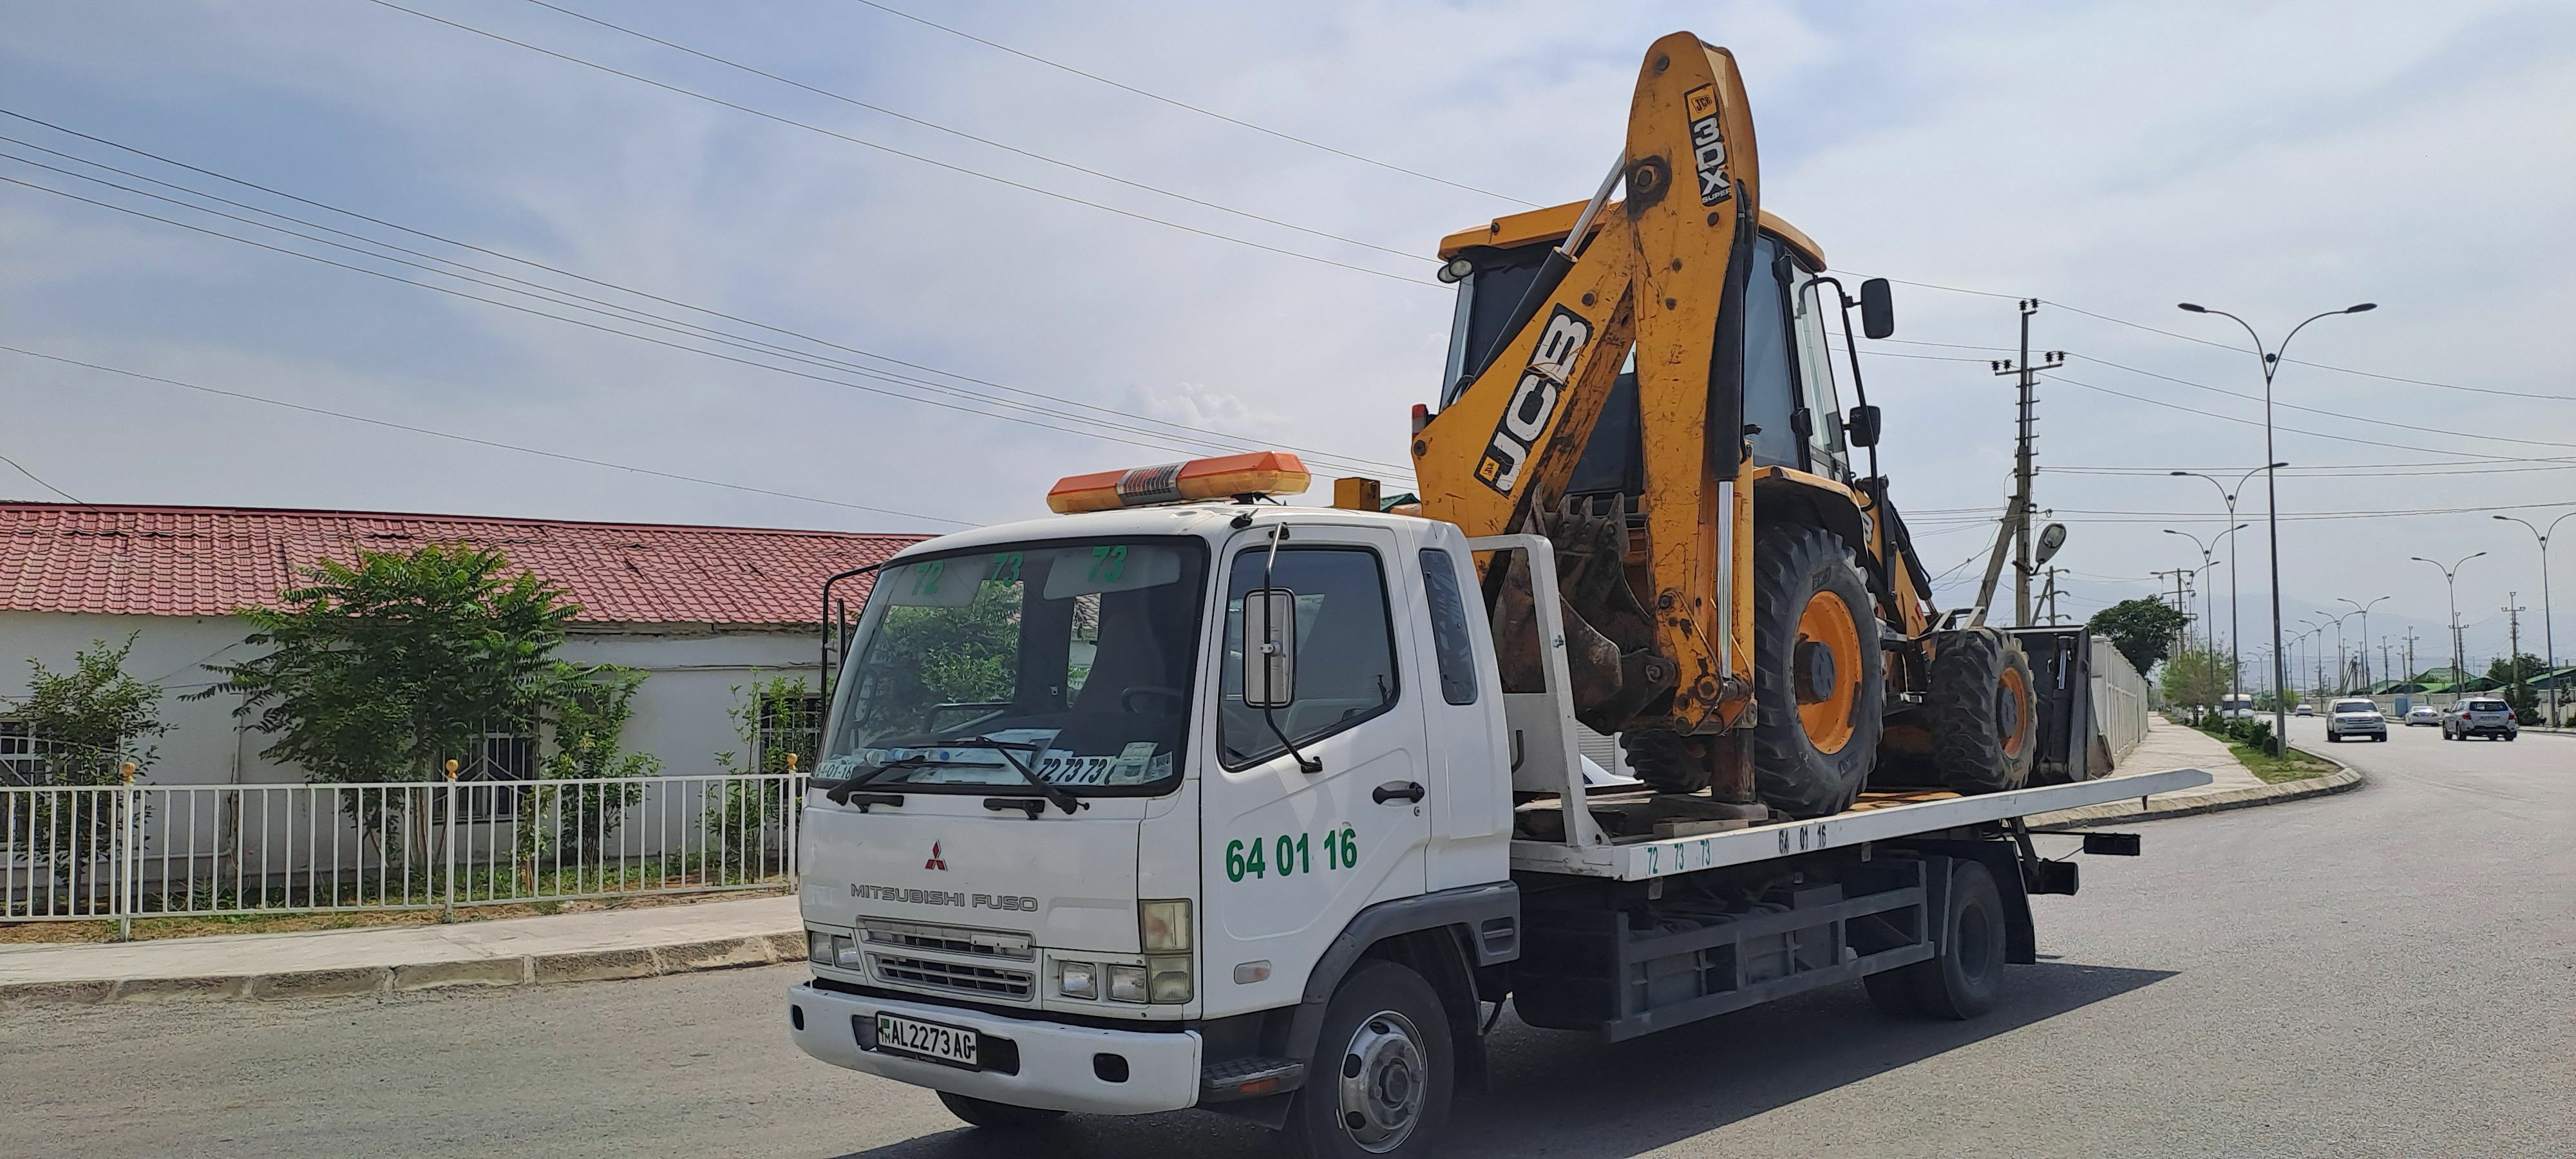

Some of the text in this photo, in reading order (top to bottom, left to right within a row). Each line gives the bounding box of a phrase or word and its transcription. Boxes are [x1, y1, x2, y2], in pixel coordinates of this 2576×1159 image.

[1695, 96, 1712, 111] JCB
[1694, 117, 1730, 196] 3DX
[1702, 190, 1732, 203] SUPER
[1493, 314, 1587, 491] JCB
[911, 545, 1128, 596] 72 73 73
[1036, 758, 1061, 781] 72
[1056, 758, 1084, 783] 73
[1079, 758, 1108, 784] 73
[1226, 828, 1358, 883] 64 01 16
[1647, 838, 1710, 874] 72 73 73
[1779, 824, 1827, 855] 64 01 16
[850, 883, 1037, 912] MITSUBISHI FUSO
